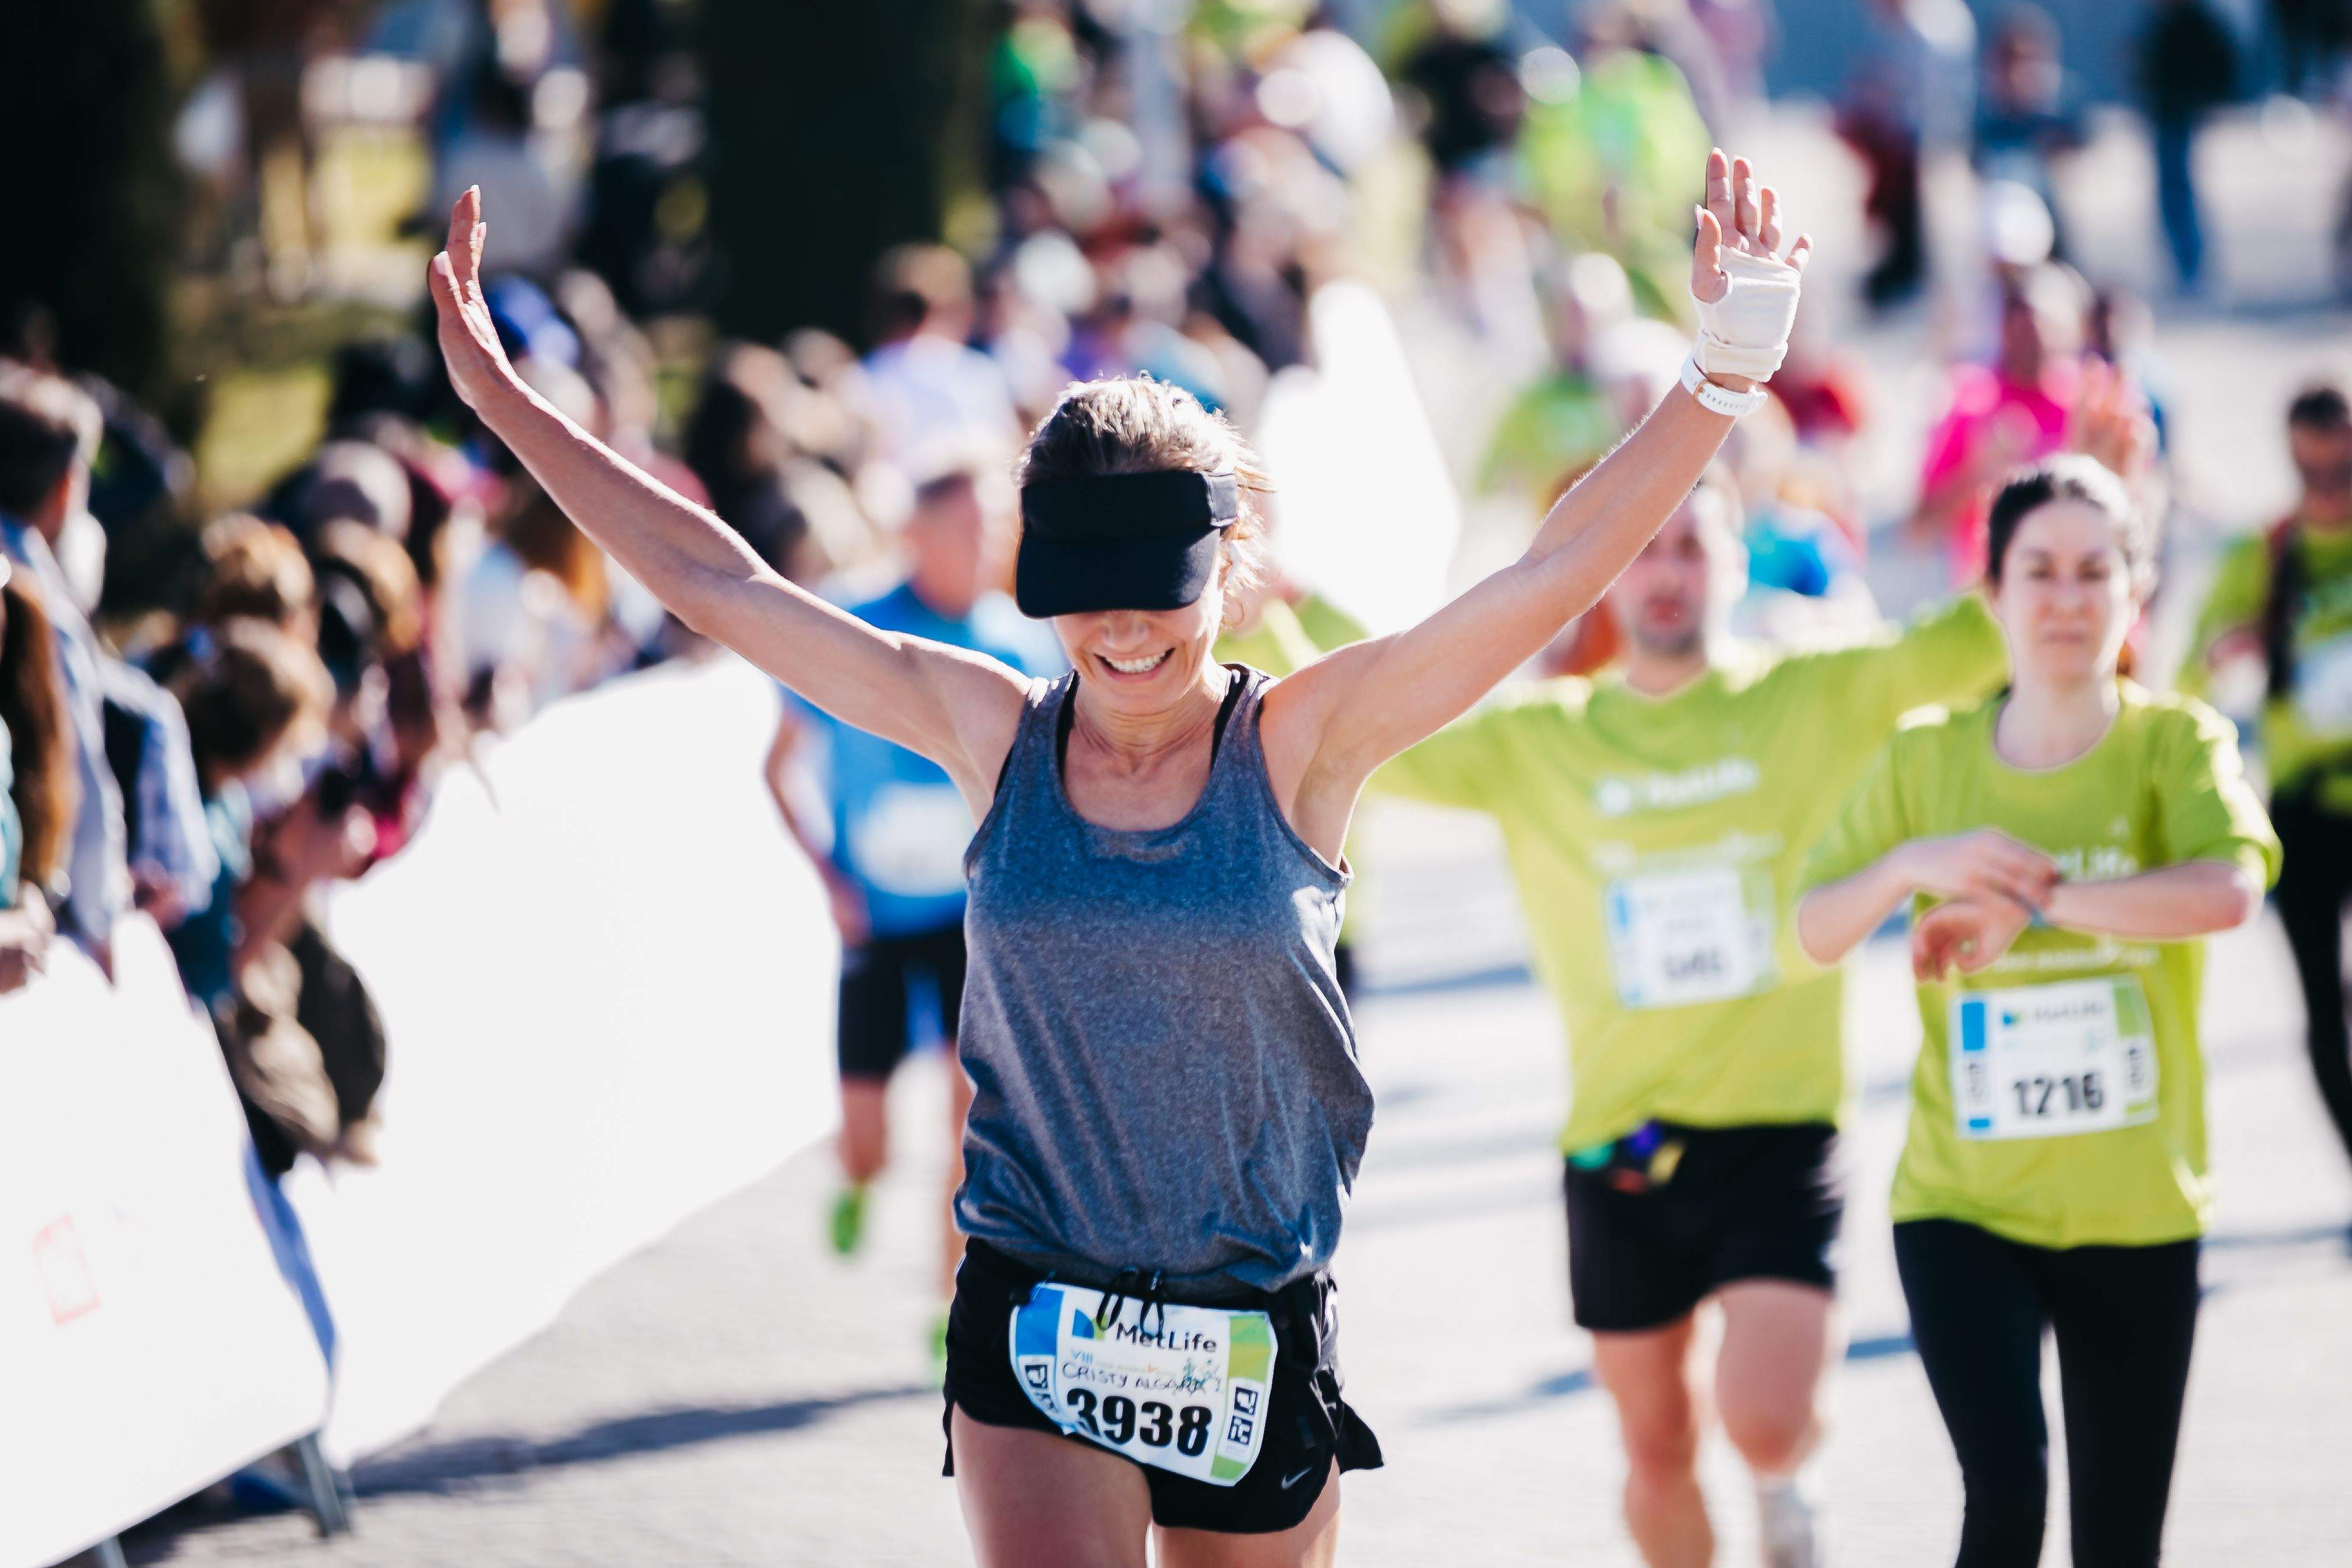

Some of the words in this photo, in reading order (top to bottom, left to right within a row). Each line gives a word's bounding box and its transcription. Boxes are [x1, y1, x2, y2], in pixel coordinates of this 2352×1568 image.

[2012, 1071, 2104, 1117] 1216
[1116, 1322, 1218, 1353] MetLife
[1066, 1387, 1212, 1457] 3938
